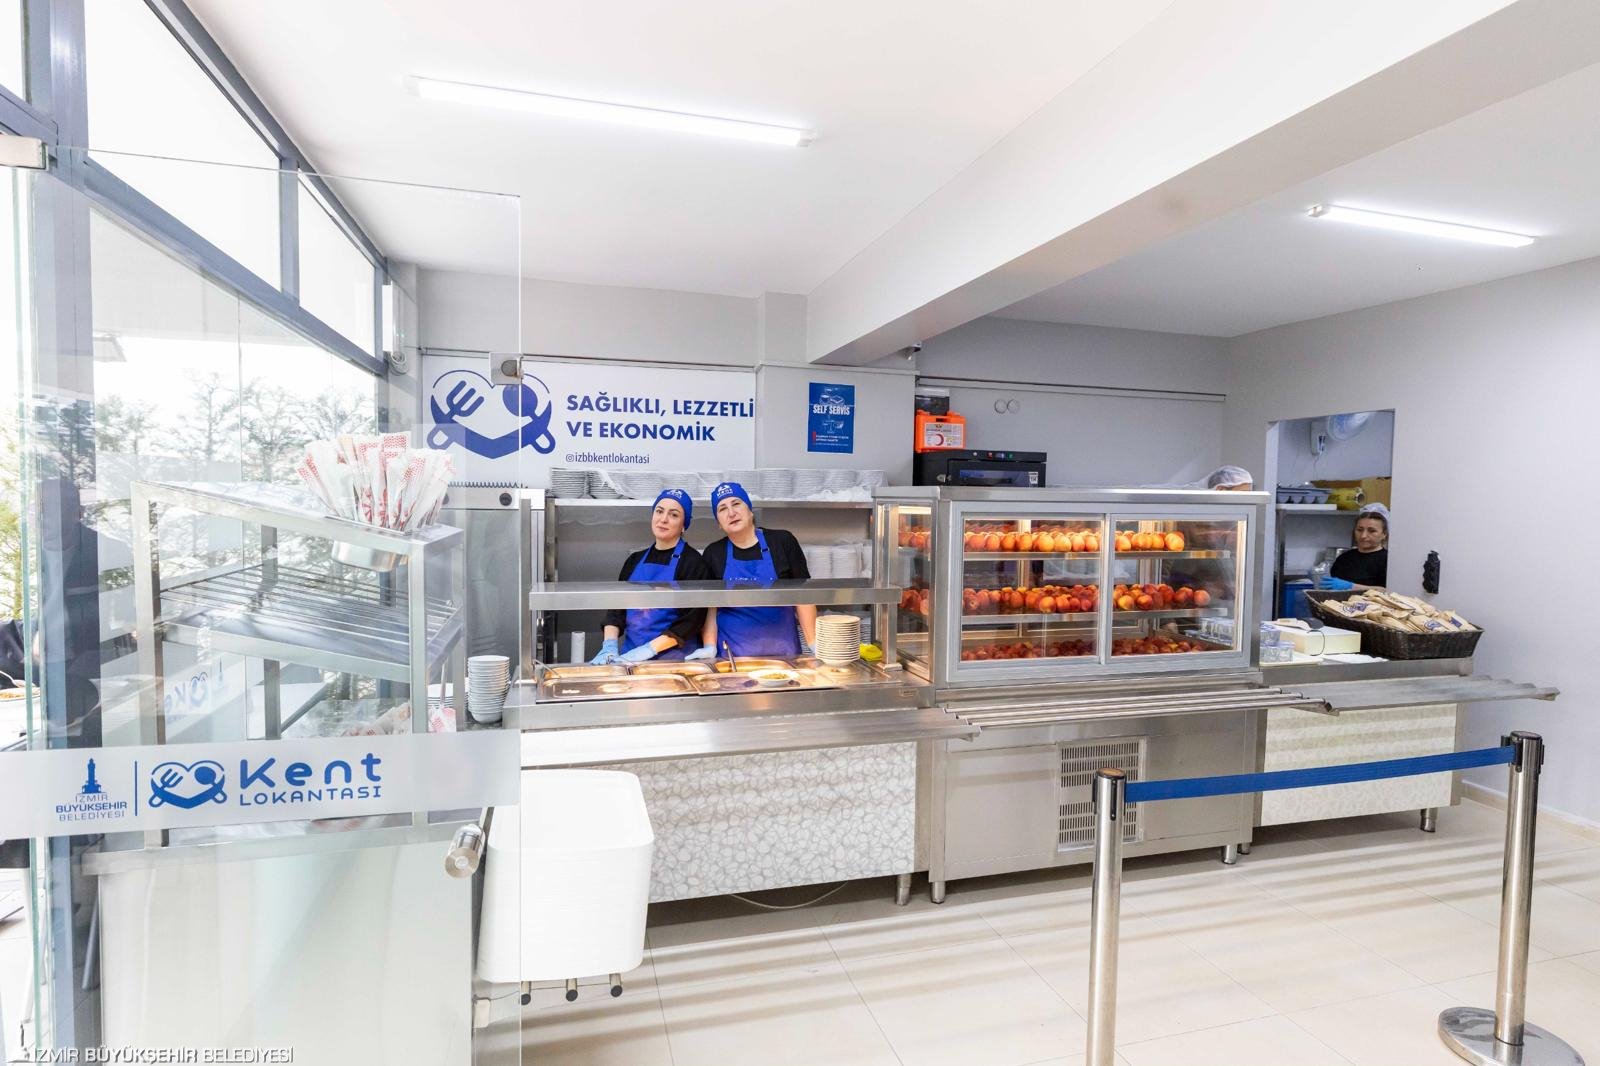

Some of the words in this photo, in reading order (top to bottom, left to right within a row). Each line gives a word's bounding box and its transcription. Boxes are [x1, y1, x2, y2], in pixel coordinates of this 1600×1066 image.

[566, 391, 666, 417] SAĞLIKLI,
[673, 398, 754, 418] LEZZETLİ
[812, 404, 828, 415] SELF
[566, 420, 593, 438] VE
[599, 421, 716, 442] EKONOMİK
[239, 752, 382, 790] Kent
[239, 786, 382, 807] LOKANTASI
